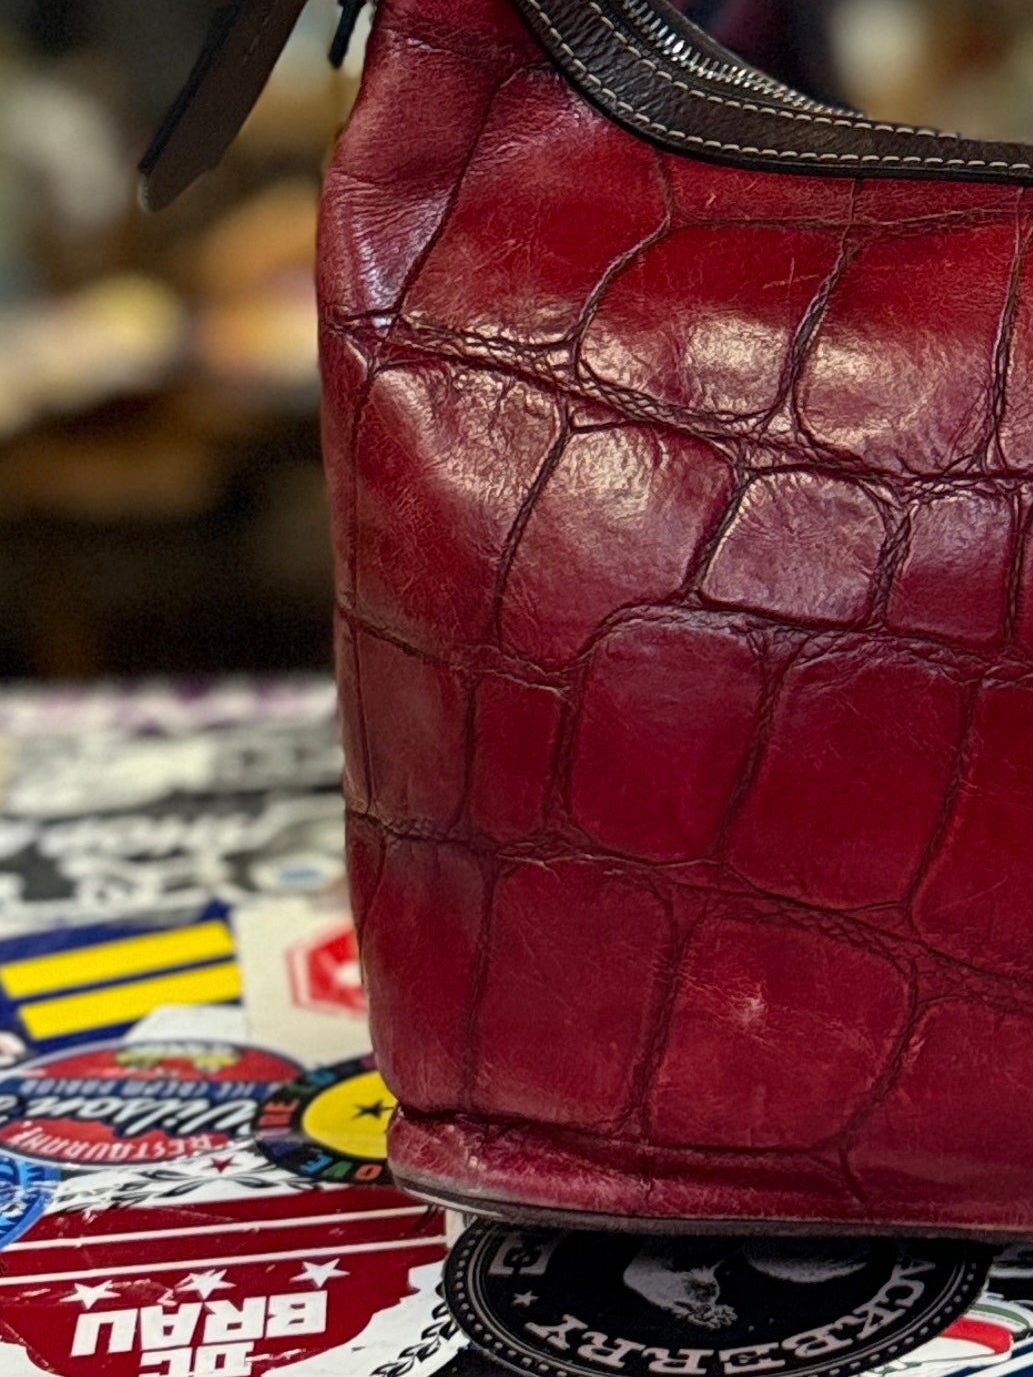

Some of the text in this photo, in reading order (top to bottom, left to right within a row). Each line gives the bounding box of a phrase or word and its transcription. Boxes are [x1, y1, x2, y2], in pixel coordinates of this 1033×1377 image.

[7, 1127, 214, 1162] RESTAURANT
[300, 1149, 383, 1182] OVE
[70, 1290, 328, 1377] DC BRAU
